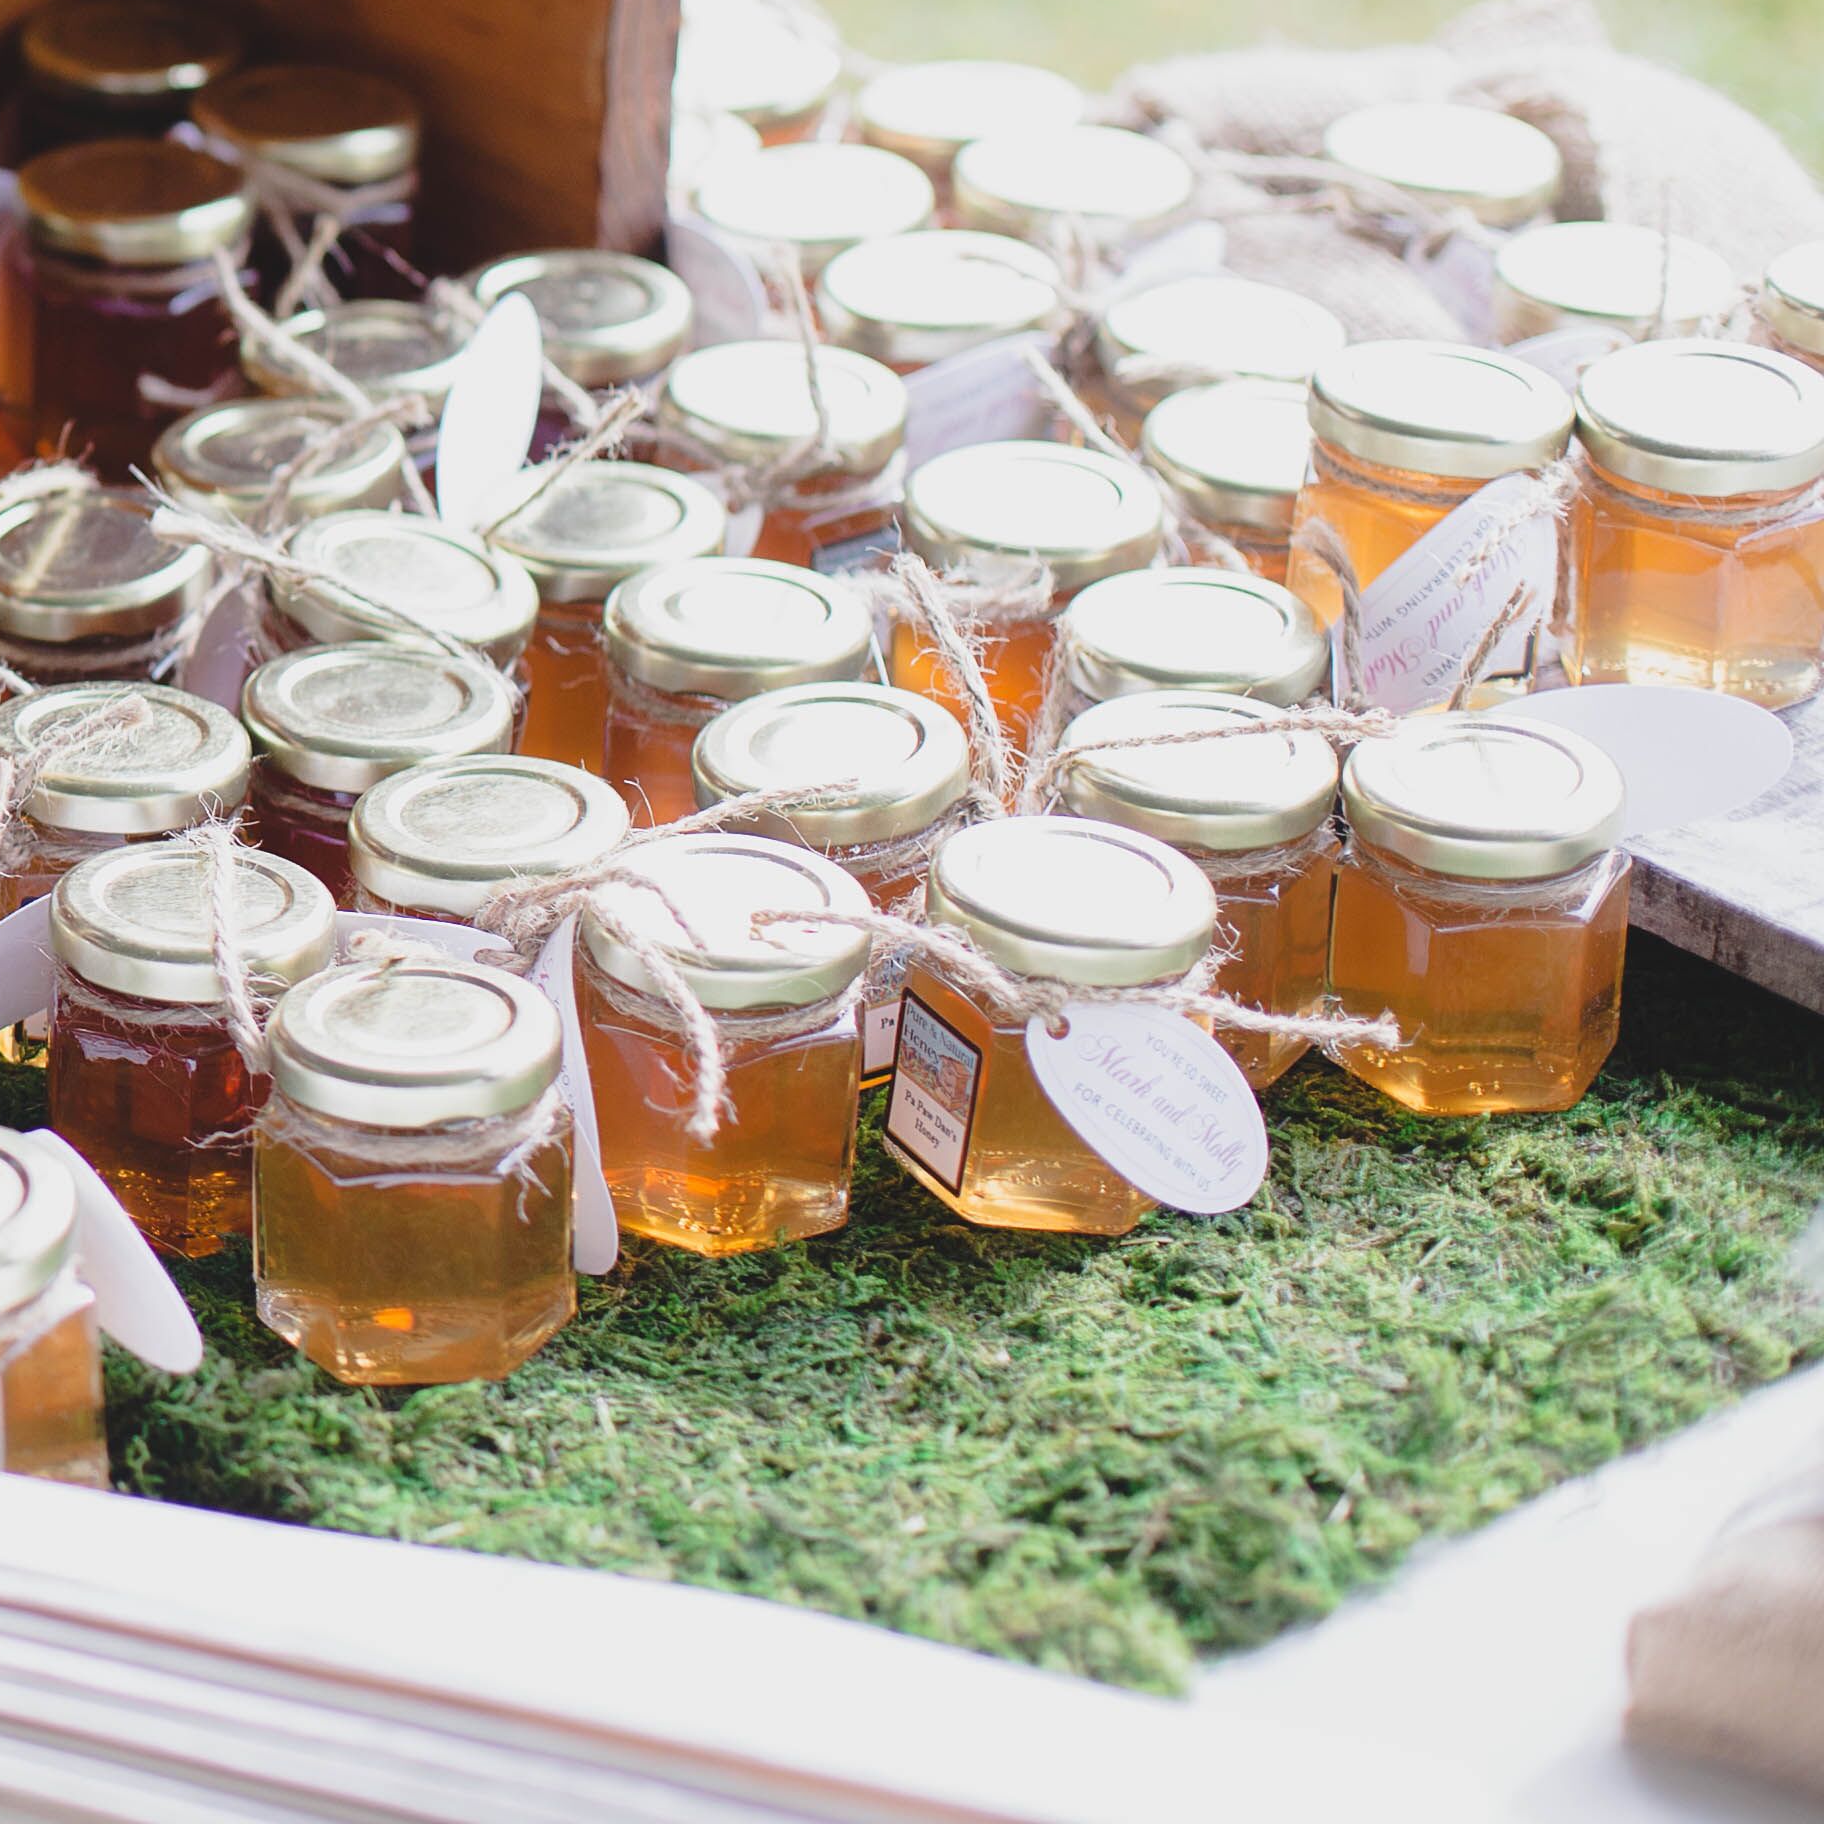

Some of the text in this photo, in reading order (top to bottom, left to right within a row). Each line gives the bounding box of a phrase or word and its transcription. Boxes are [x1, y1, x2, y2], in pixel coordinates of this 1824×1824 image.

[1364, 616, 1397, 642] WITH
[1428, 590, 1465, 648] and
[880, 1017, 895, 1029] Pa
[903, 1023, 940, 1065] Honey
[905, 1002, 974, 1068] Pure & Natural
[1146, 1031, 1229, 1105] YOU'RE SO SWEET
[904, 1089, 957, 1143] Pa Paw Dan's
[914, 1117, 940, 1149] Honey
[1075, 1032, 1248, 1182] Mark and Molly
[1073, 1082, 1212, 1192] FOR CELEBRATING WITH US
